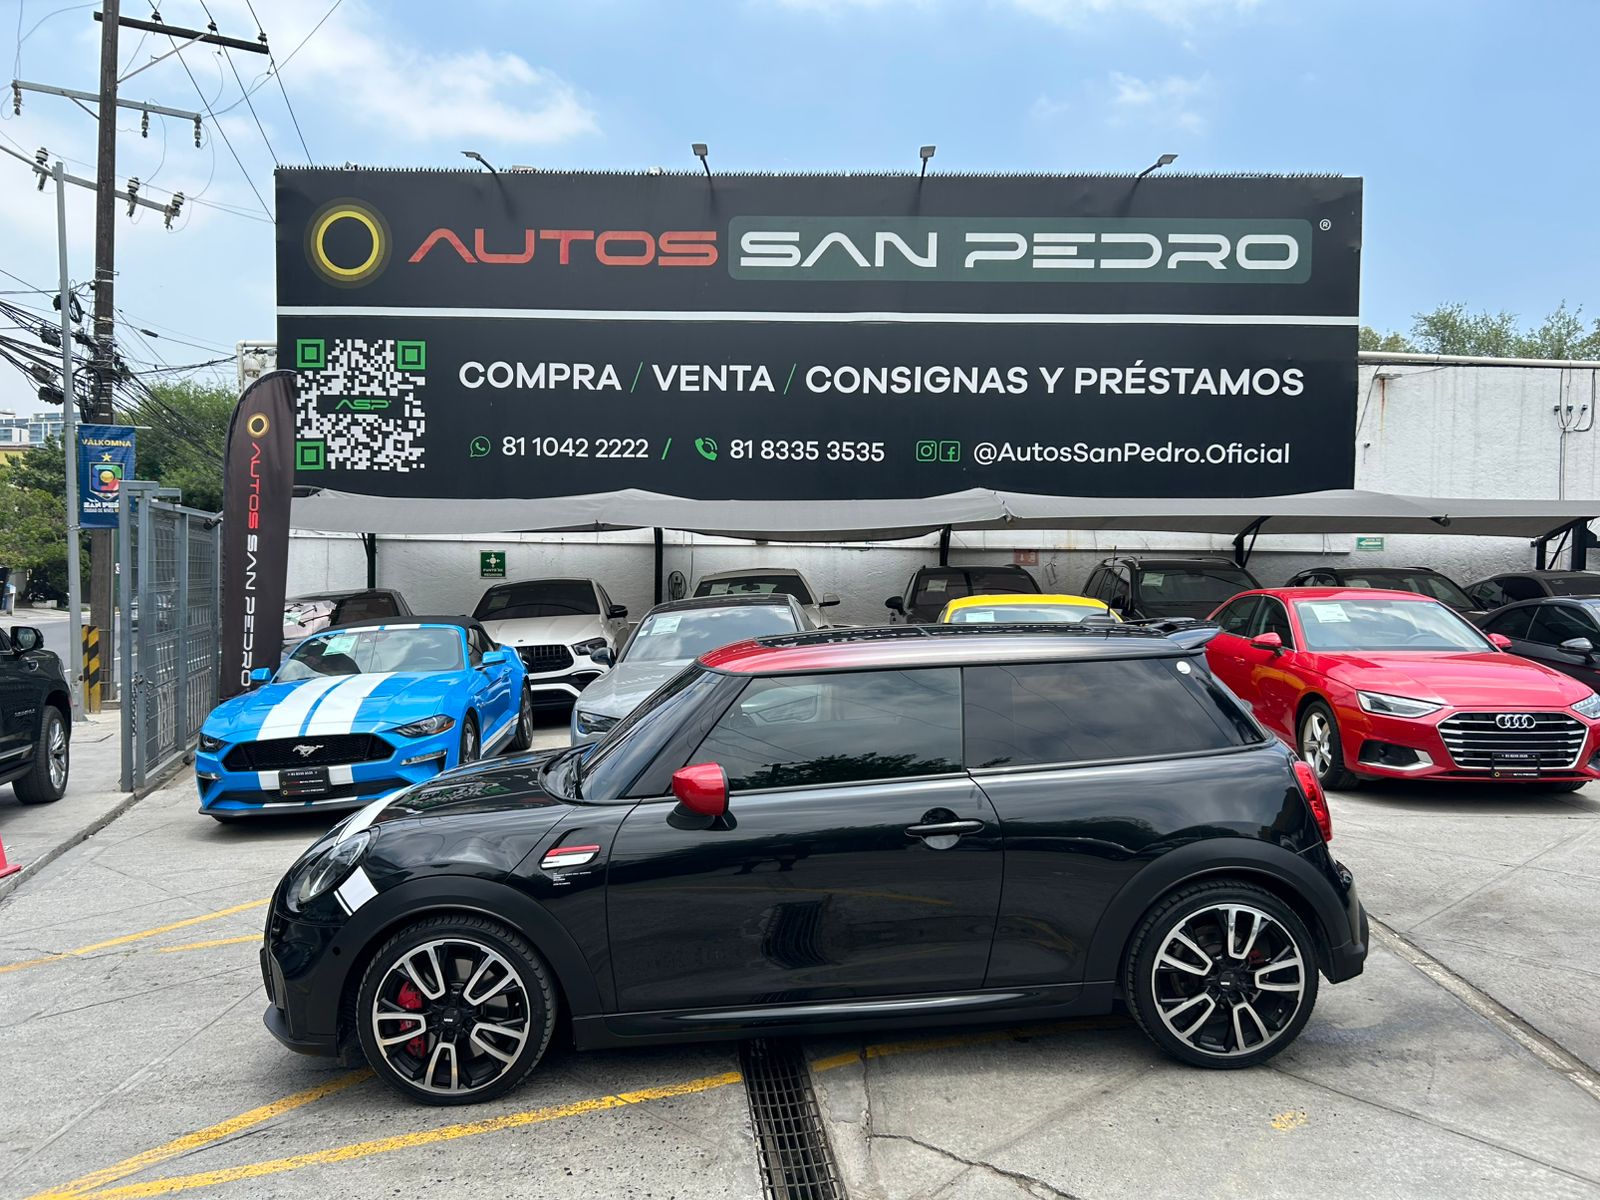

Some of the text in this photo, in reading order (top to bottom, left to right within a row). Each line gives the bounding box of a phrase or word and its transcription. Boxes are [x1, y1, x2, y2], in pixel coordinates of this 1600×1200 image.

[408, 228, 719, 267] AUTOS
[740, 231, 938, 269] SAN
[964, 232, 1299, 271] PEDRO
[458, 360, 623, 393] COMPRA
[651, 363, 776, 393] VENTA
[805, 365, 1029, 395] CONSIGNAS
[1038, 366, 1065, 395] Y
[1074, 359, 1305, 397] PRÉSTAMOS
[335, 398, 389, 410] ASP
[501, 435, 525, 456] 81
[531, 436, 589, 458] 1042
[594, 438, 649, 459] 2222
[729, 438, 753, 459] 81
[760, 439, 820, 461] 8335
[826, 440, 885, 463] 3535
[973, 441, 1291, 466] @AutosSanPedro.Oficial
[241, 442, 261, 688] AUTOS SAN PEDRO
